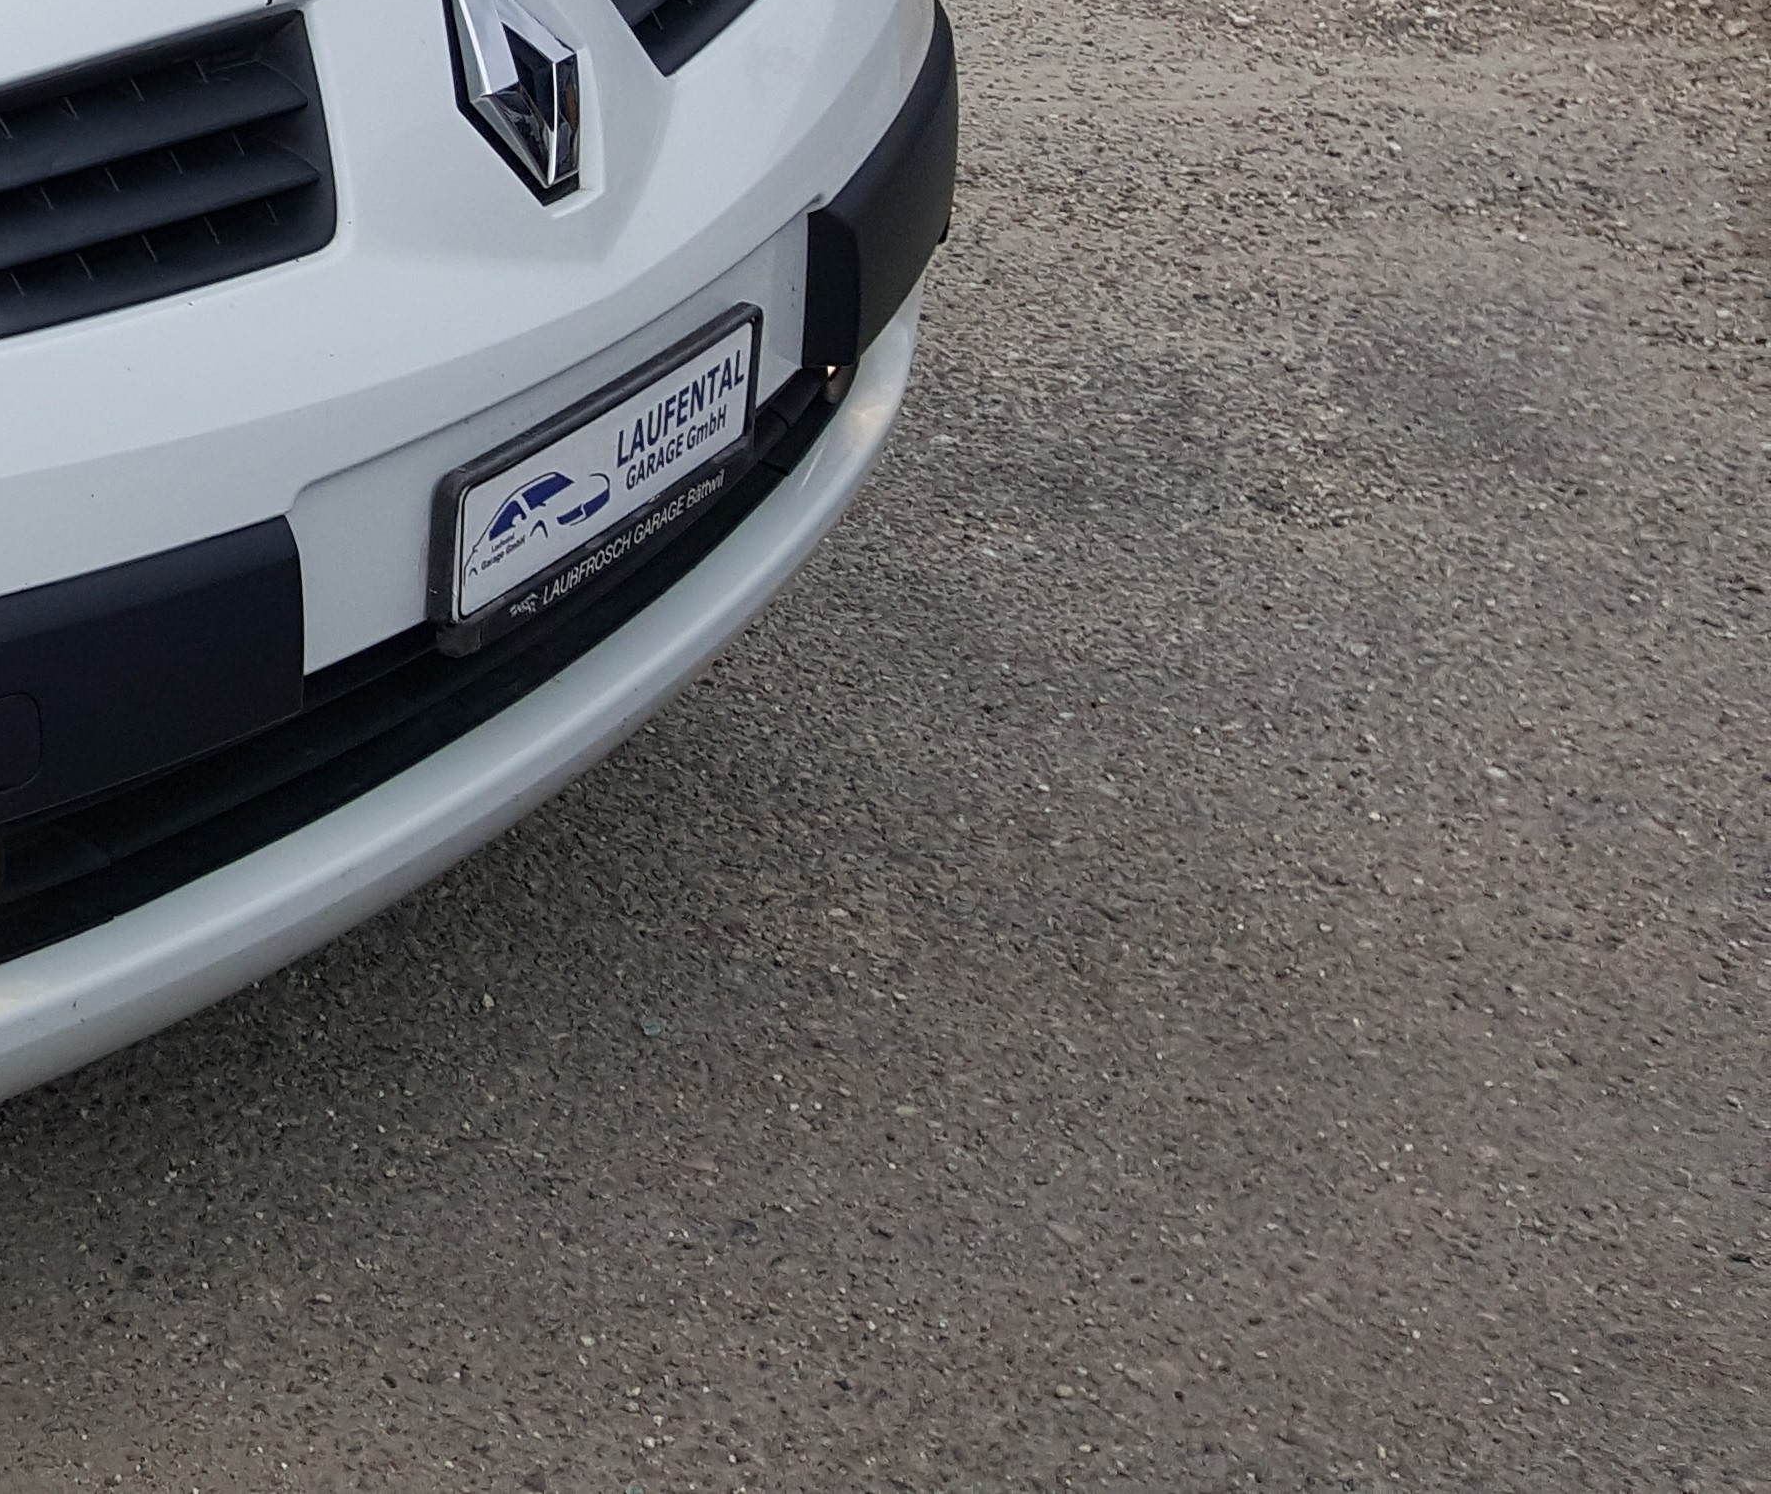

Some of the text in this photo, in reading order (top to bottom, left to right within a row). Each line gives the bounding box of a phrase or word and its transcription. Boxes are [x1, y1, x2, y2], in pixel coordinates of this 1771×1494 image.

[617, 349, 745, 468] LAUFENTAL
[626, 403, 727, 491] GARAGE GmbH
[542, 531, 632, 605] LAUBFROSCH
[633, 494, 687, 545] GARAGE
